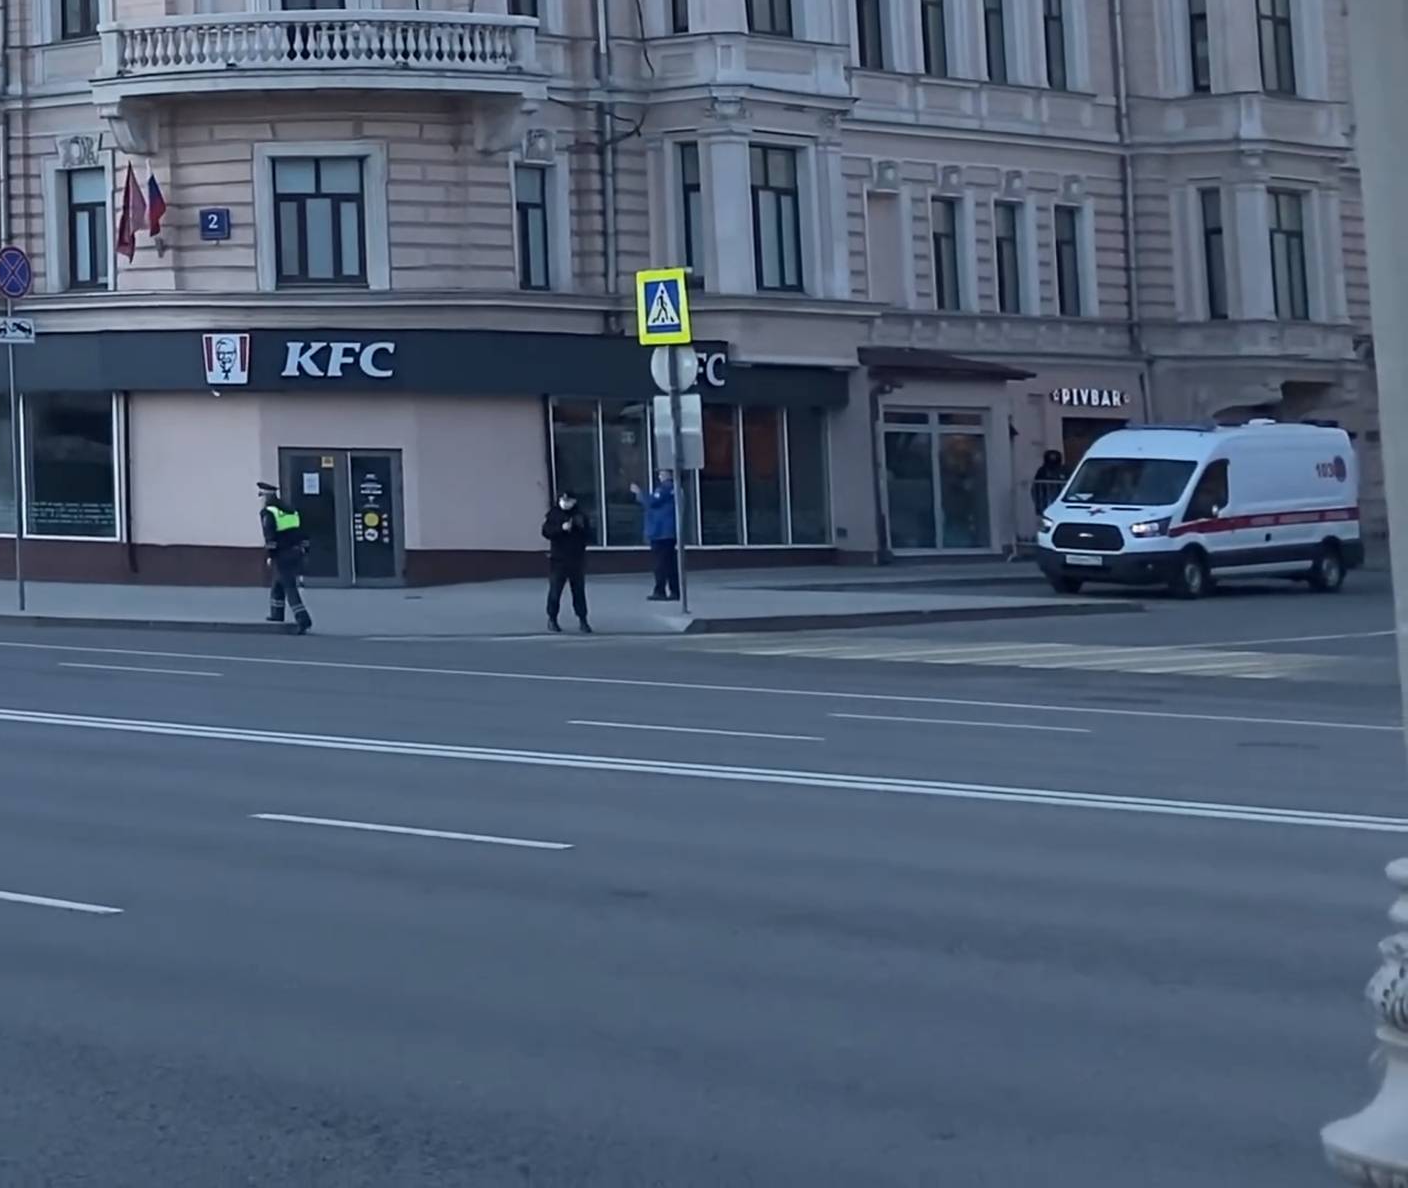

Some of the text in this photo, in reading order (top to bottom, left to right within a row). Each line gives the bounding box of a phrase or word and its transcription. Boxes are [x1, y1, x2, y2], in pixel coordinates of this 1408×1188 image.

[207, 214, 219, 229] 2
[281, 342, 395, 378] KFC
[1062, 388, 1122, 406] PIVBAR
